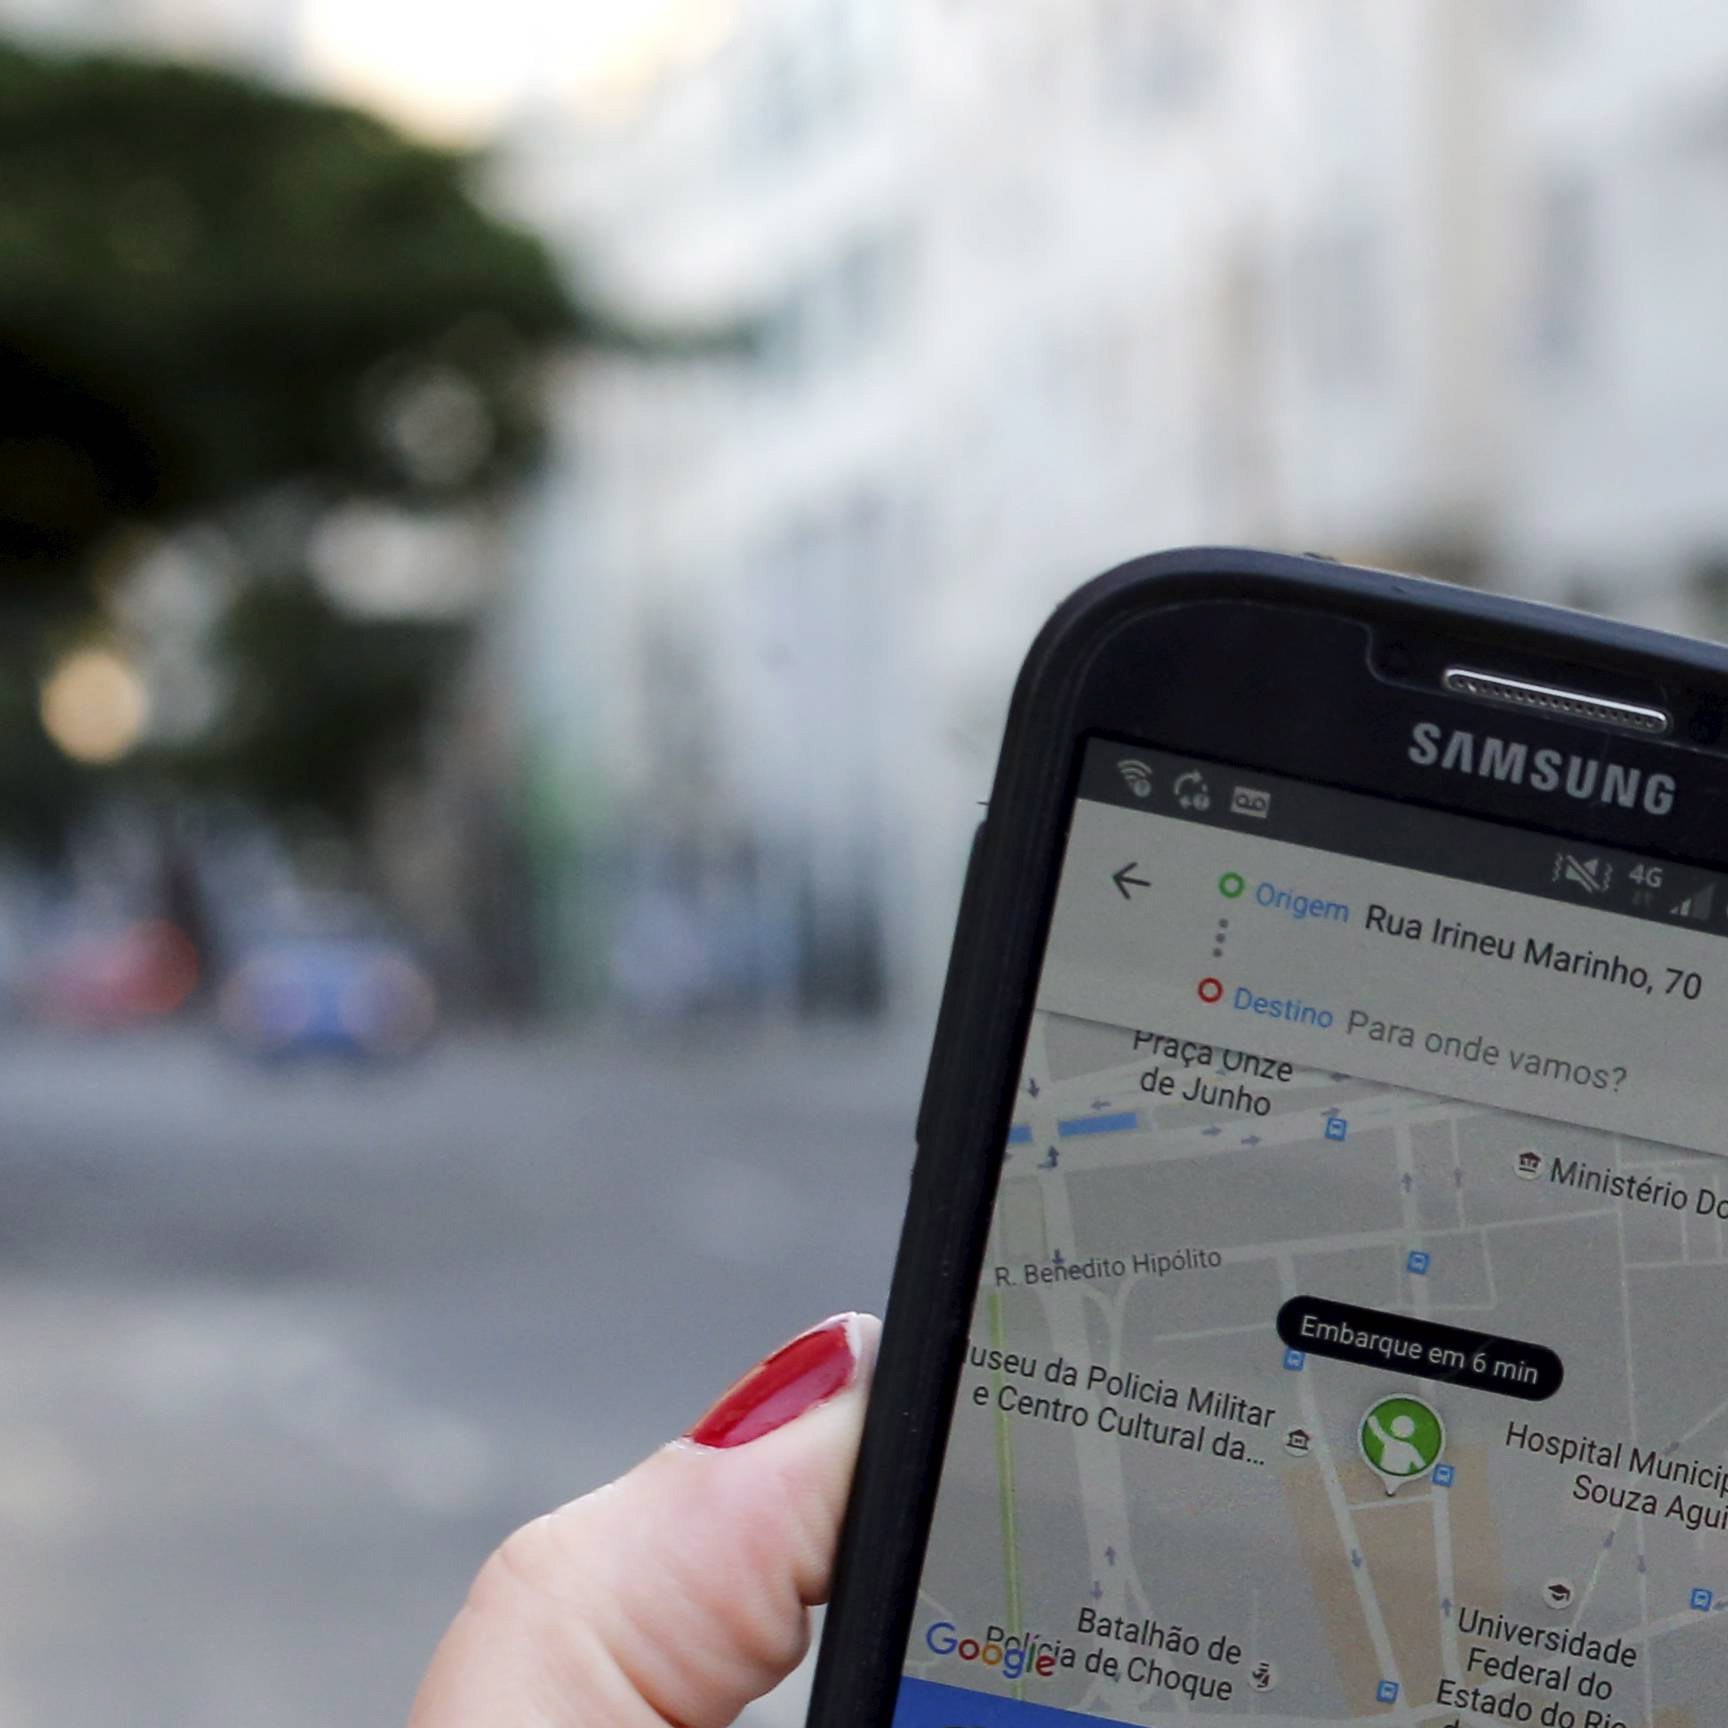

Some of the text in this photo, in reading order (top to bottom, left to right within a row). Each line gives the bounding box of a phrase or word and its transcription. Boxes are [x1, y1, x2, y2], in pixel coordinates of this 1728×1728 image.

[1408, 722, 1676, 815] SAMSUNG
[1629, 864, 1663, 888] 4G
[1256, 882, 1702, 1000] Origem Rua Irineu Marinho, 70
[1133, 1030, 1293, 1082] Praça Onze
[1233, 986, 1627, 1093] Destino Para onde vamos?
[1140, 1067, 1271, 1116] de Junho
[1550, 1157, 1688, 1210] Ministério
[995, 1248, 1222, 1287] R. Benedito Hipólito
[1300, 1314, 1539, 1385] Embarque em 6 min
[963, 1345, 1276, 1428] useu da Policia Militar
[973, 1385, 1265, 1465] e Centro Cultural da...
[1506, 1422, 1622, 1469] Hospital
[1572, 1474, 1657, 1515] Souza
[926, 1622, 1056, 1679] Google
[1078, 1607, 1242, 1665] Batalhão de
[1458, 1607, 1637, 1668] Universidade
[1085, 1648, 1118, 1677] de
[1128, 1657, 1233, 1700] Choque
[1467, 1647, 1613, 1700] Federal do
[1436, 1679, 1533, 1722] Estado
